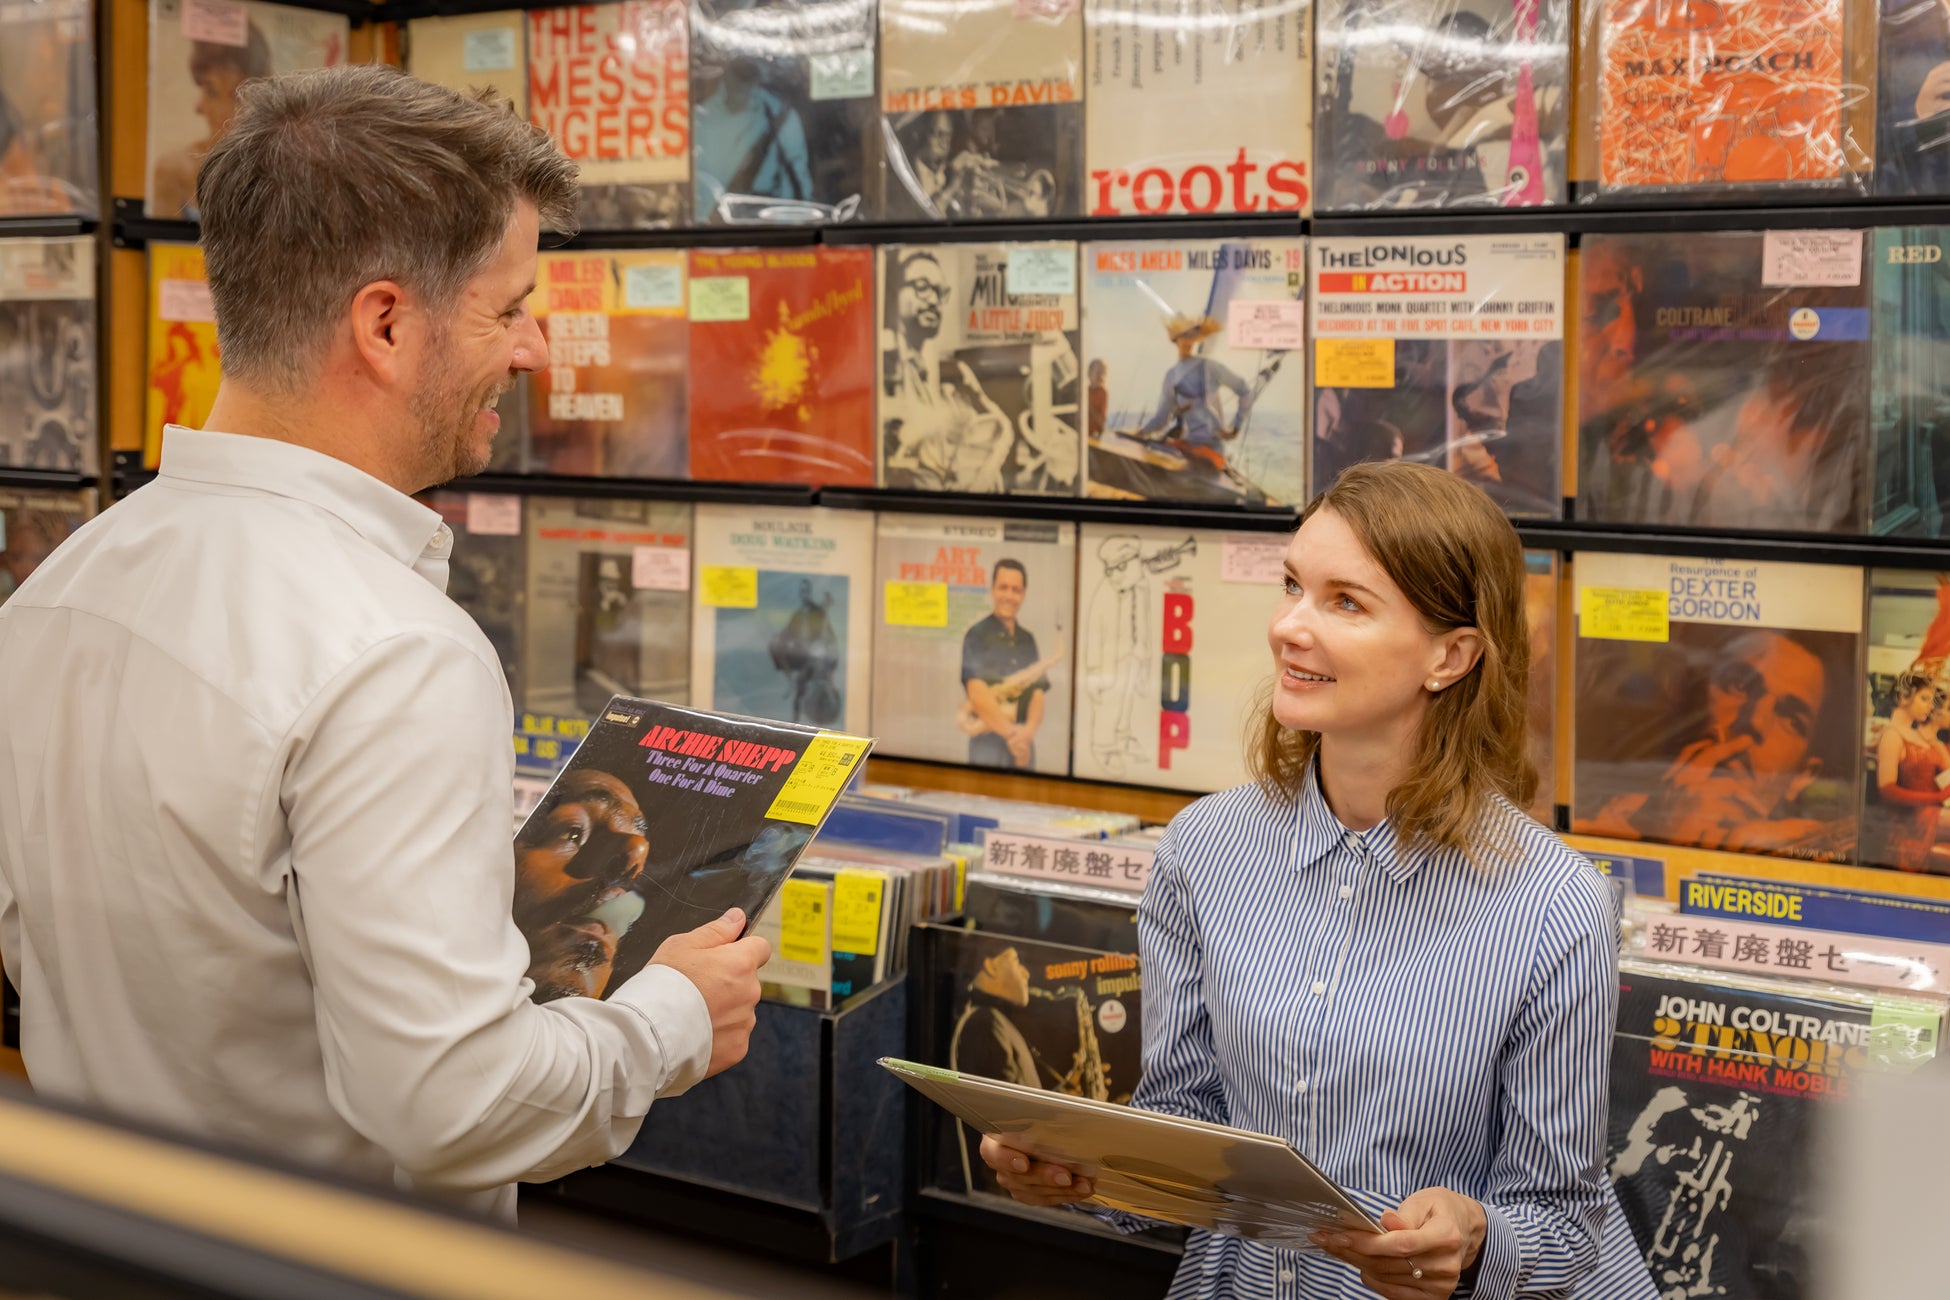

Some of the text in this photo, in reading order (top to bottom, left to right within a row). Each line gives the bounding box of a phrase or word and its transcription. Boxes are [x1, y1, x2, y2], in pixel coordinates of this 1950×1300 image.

[529, 6, 597, 57] THE
[1624, 51, 1815, 77] MAX ROACH
[529, 52, 689, 108] MESSE
[887, 87, 977, 112] MILES
[991, 81, 1074, 106] DAVIS
[1356, 158, 1407, 174] SONNY
[1091, 147, 1309, 216] roots
[1096, 250, 1136, 271] MILES
[1141, 250, 1183, 270] AHEAD
[1189, 250, 1228, 270] MILES
[1234, 249, 1272, 269] DAVIS
[1888, 245, 1942, 264] RED
[1352, 273, 1464, 291] IN ACTION
[969, 310, 979, 330] A
[1318, 302, 1373, 313] THELONIOUS
[1377, 302, 1402, 313] MONK
[1407, 302, 1446, 313] QUARTET
[1451, 302, 1475, 313] WITH
[1518, 301, 1555, 313] GRIFFIN
[1656, 307, 1733, 327] COLTRANE
[1318, 319, 1363, 331] RECORDED
[1367, 319, 1377, 331] AT
[1381, 319, 1397, 331] THE
[1425, 319, 1447, 331] SPOT
[1481, 318, 1500, 331] NEW
[1506, 318, 1529, 331] YORK
[1534, 318, 1555, 331] CITY
[935, 546, 982, 566] ART
[899, 562, 986, 587] PEPPER
[1670, 563, 1758, 578] Resurgence of
[1671, 576, 1757, 600] DEXTER
[1668, 597, 1761, 621] GORDON
[1158, 592, 1195, 770] BOP
[638, 725, 797, 773] ARCHIE SHEPP
[646, 750, 764, 785] Three For A Quarter
[648, 768, 736, 798] One For A Dime
[990, 839, 1152, 881] 新着廃盤セ
[1688, 882, 1803, 921] RIVERSIDE
[1045, 951, 1137, 980] sonny rollins
[1650, 1017, 1681, 1051] 2
[1655, 996, 1870, 1047] JOHN COLTRANE
[1650, 1050, 1856, 1098] WITH HANK MOBLE
